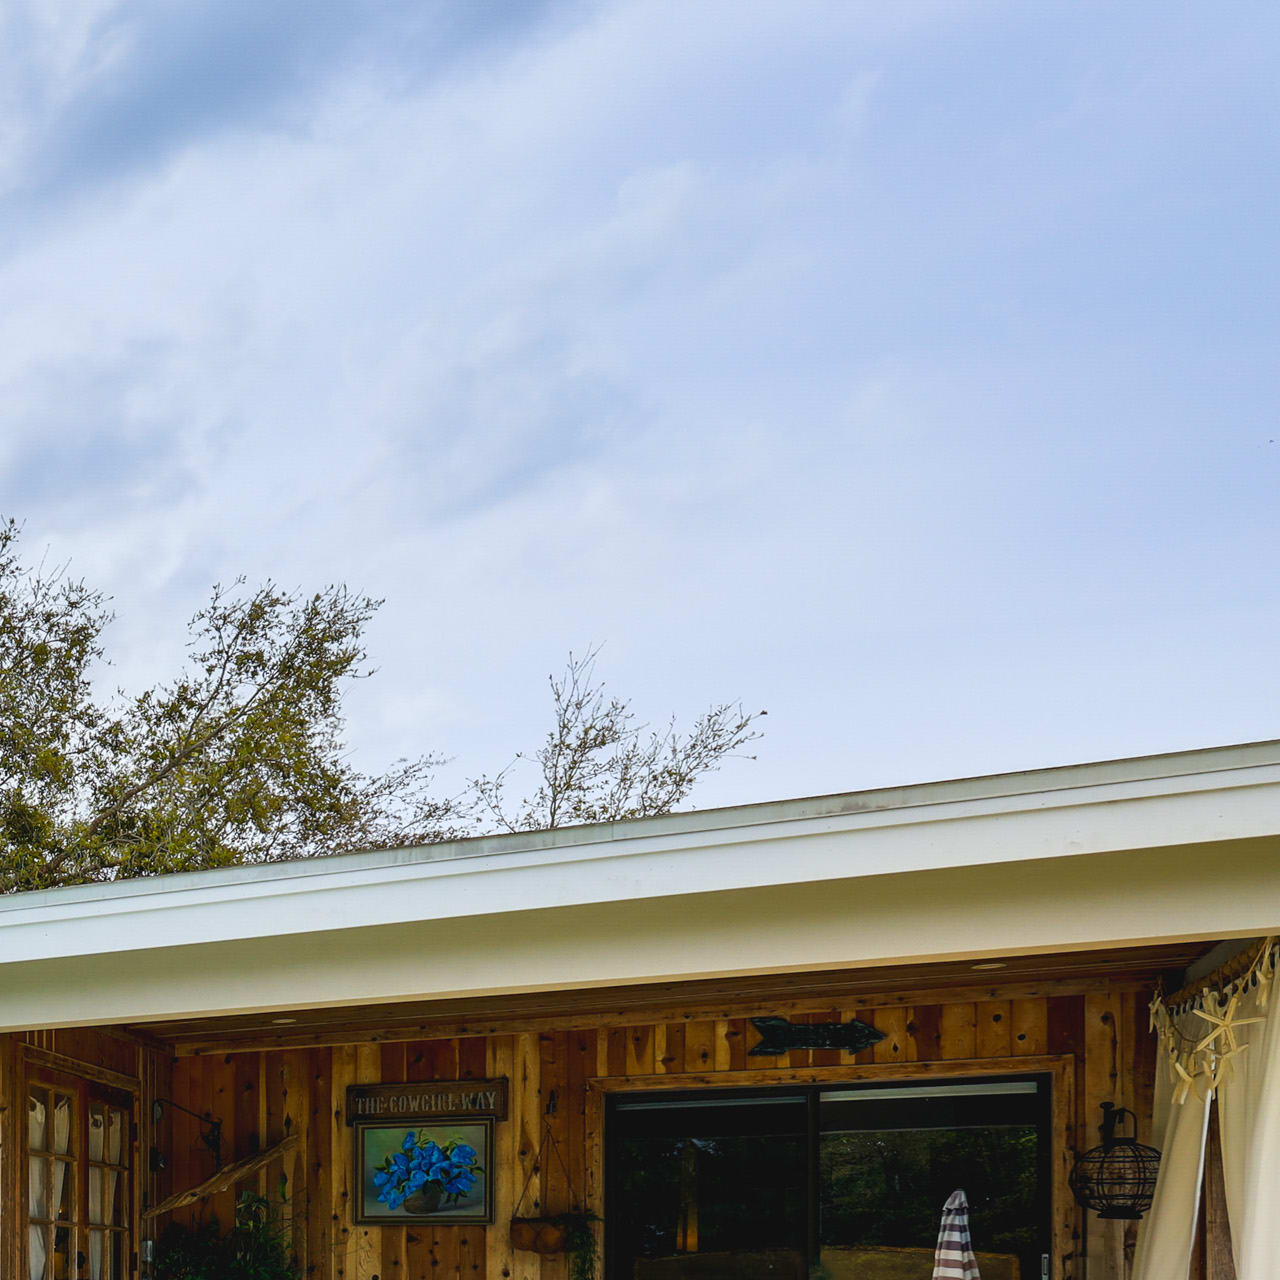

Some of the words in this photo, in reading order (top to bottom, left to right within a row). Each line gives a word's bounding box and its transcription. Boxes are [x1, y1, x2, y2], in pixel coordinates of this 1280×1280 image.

[355, 1096, 384, 1114] THE
[389, 1093, 456, 1113] COWGIRL
[461, 1091, 497, 1110] WAY
